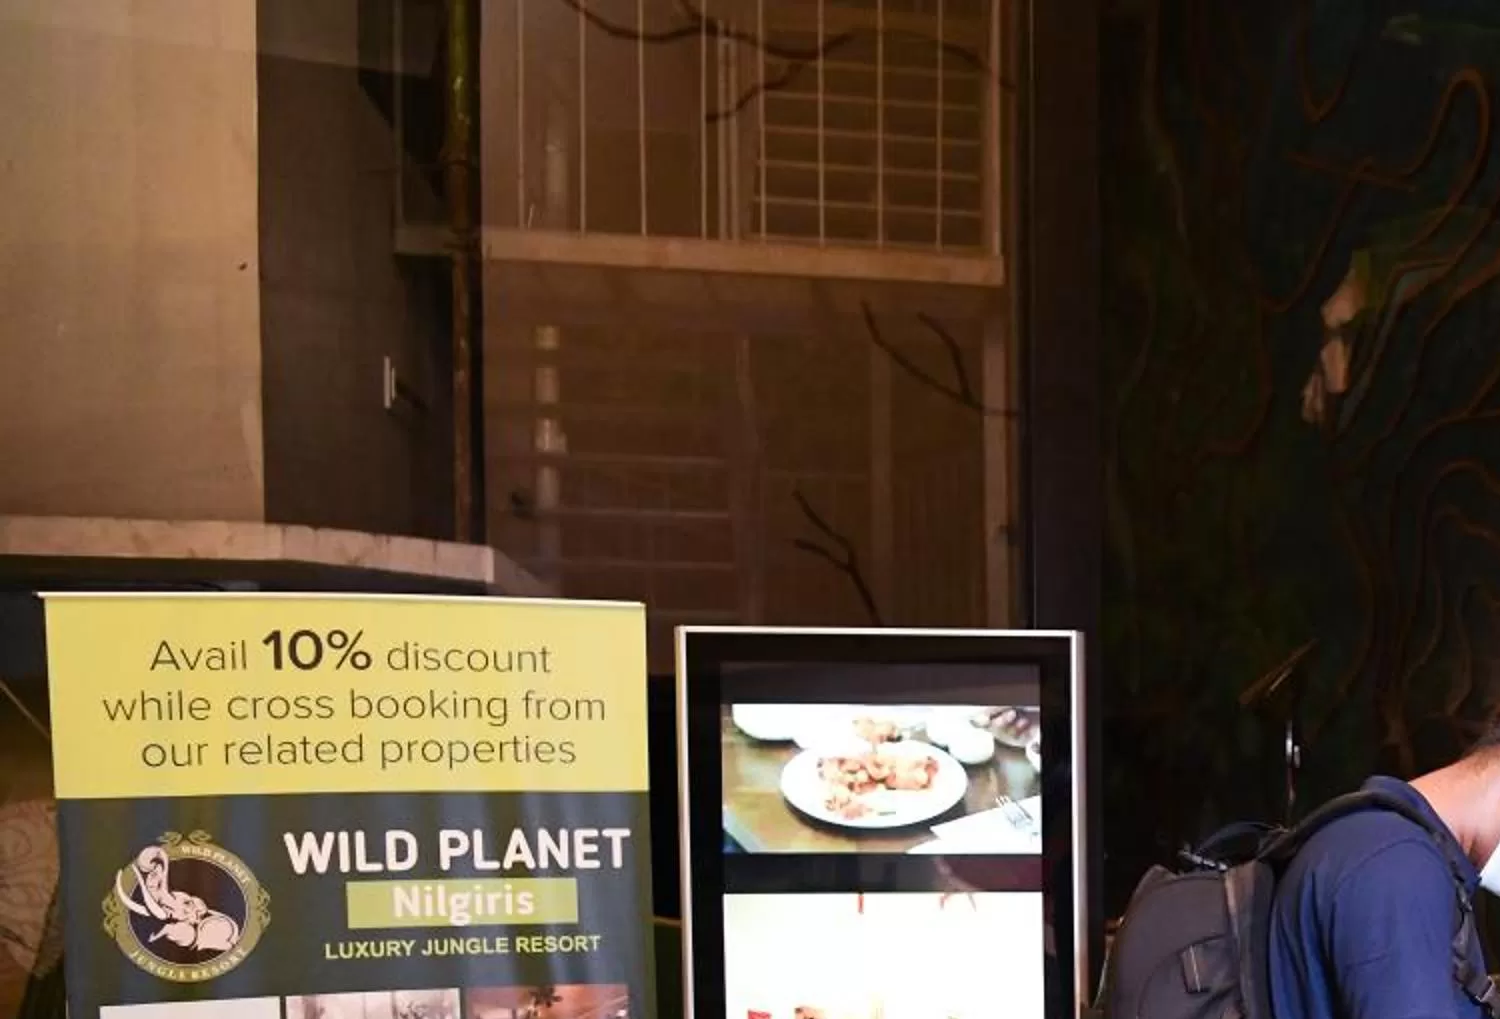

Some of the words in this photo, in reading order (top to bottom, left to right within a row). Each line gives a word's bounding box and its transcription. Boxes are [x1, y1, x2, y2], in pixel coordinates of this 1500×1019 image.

[150, 638, 247, 672] Avail
[262, 629, 373, 672] 10%
[387, 641, 551, 673] discount
[102, 689, 212, 722] while
[227, 692, 335, 719] cross
[350, 689, 508, 727] booking
[521, 689, 606, 721] from
[142, 738, 207, 768] our
[224, 733, 364, 765] related
[380, 735, 576, 770] properties
[284, 831, 418, 874] WILD
[439, 829, 631, 870] PLANET
[393, 883, 534, 926] Nilgiris
[325, 939, 416, 959] LUXURY
[421, 938, 509, 957] JUNGLE
[515, 935, 601, 955] RESORT
